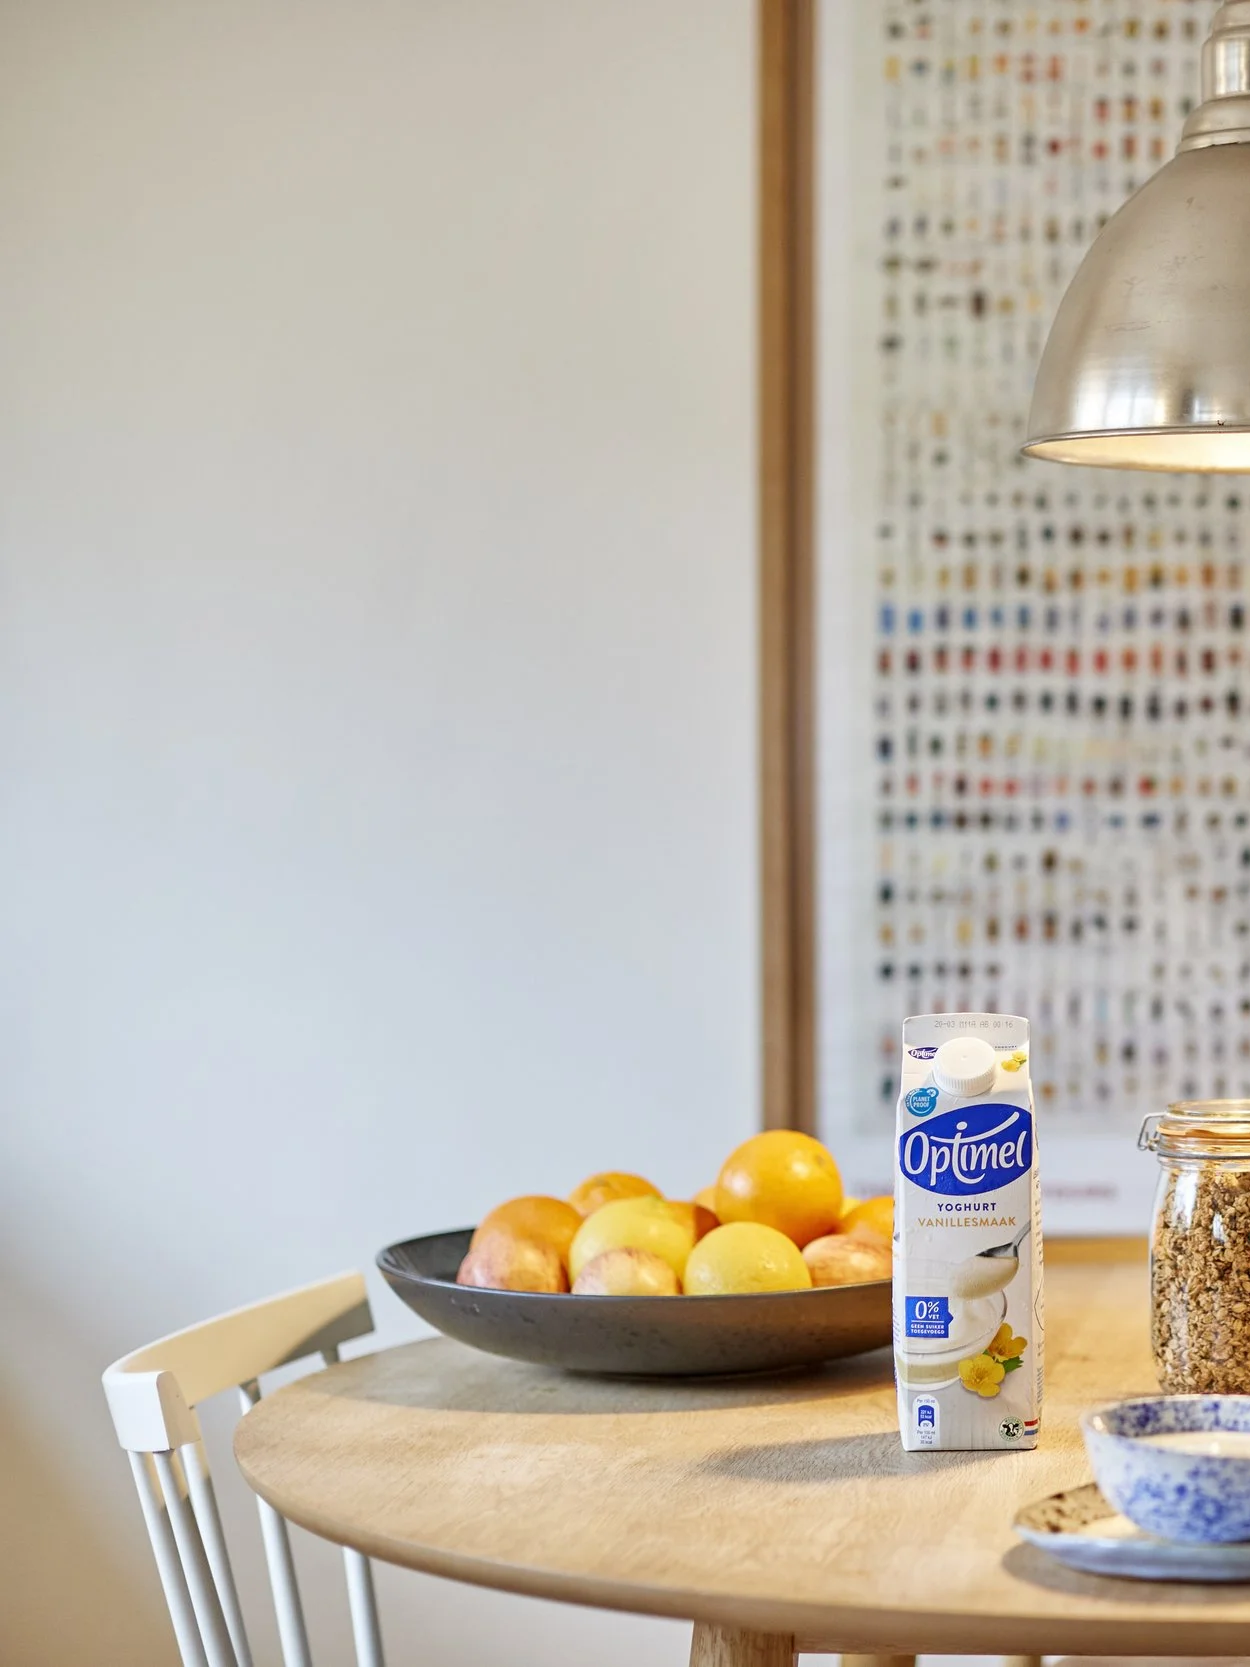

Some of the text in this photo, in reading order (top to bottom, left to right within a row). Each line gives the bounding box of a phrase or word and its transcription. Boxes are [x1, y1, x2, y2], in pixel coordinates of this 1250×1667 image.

[904, 1112, 1027, 1187] Optimel
[937, 1203, 997, 1212] YOGHURT
[917, 1216, 1016, 1226] VANILLESMAAK
[915, 1300, 940, 1319] 0%
